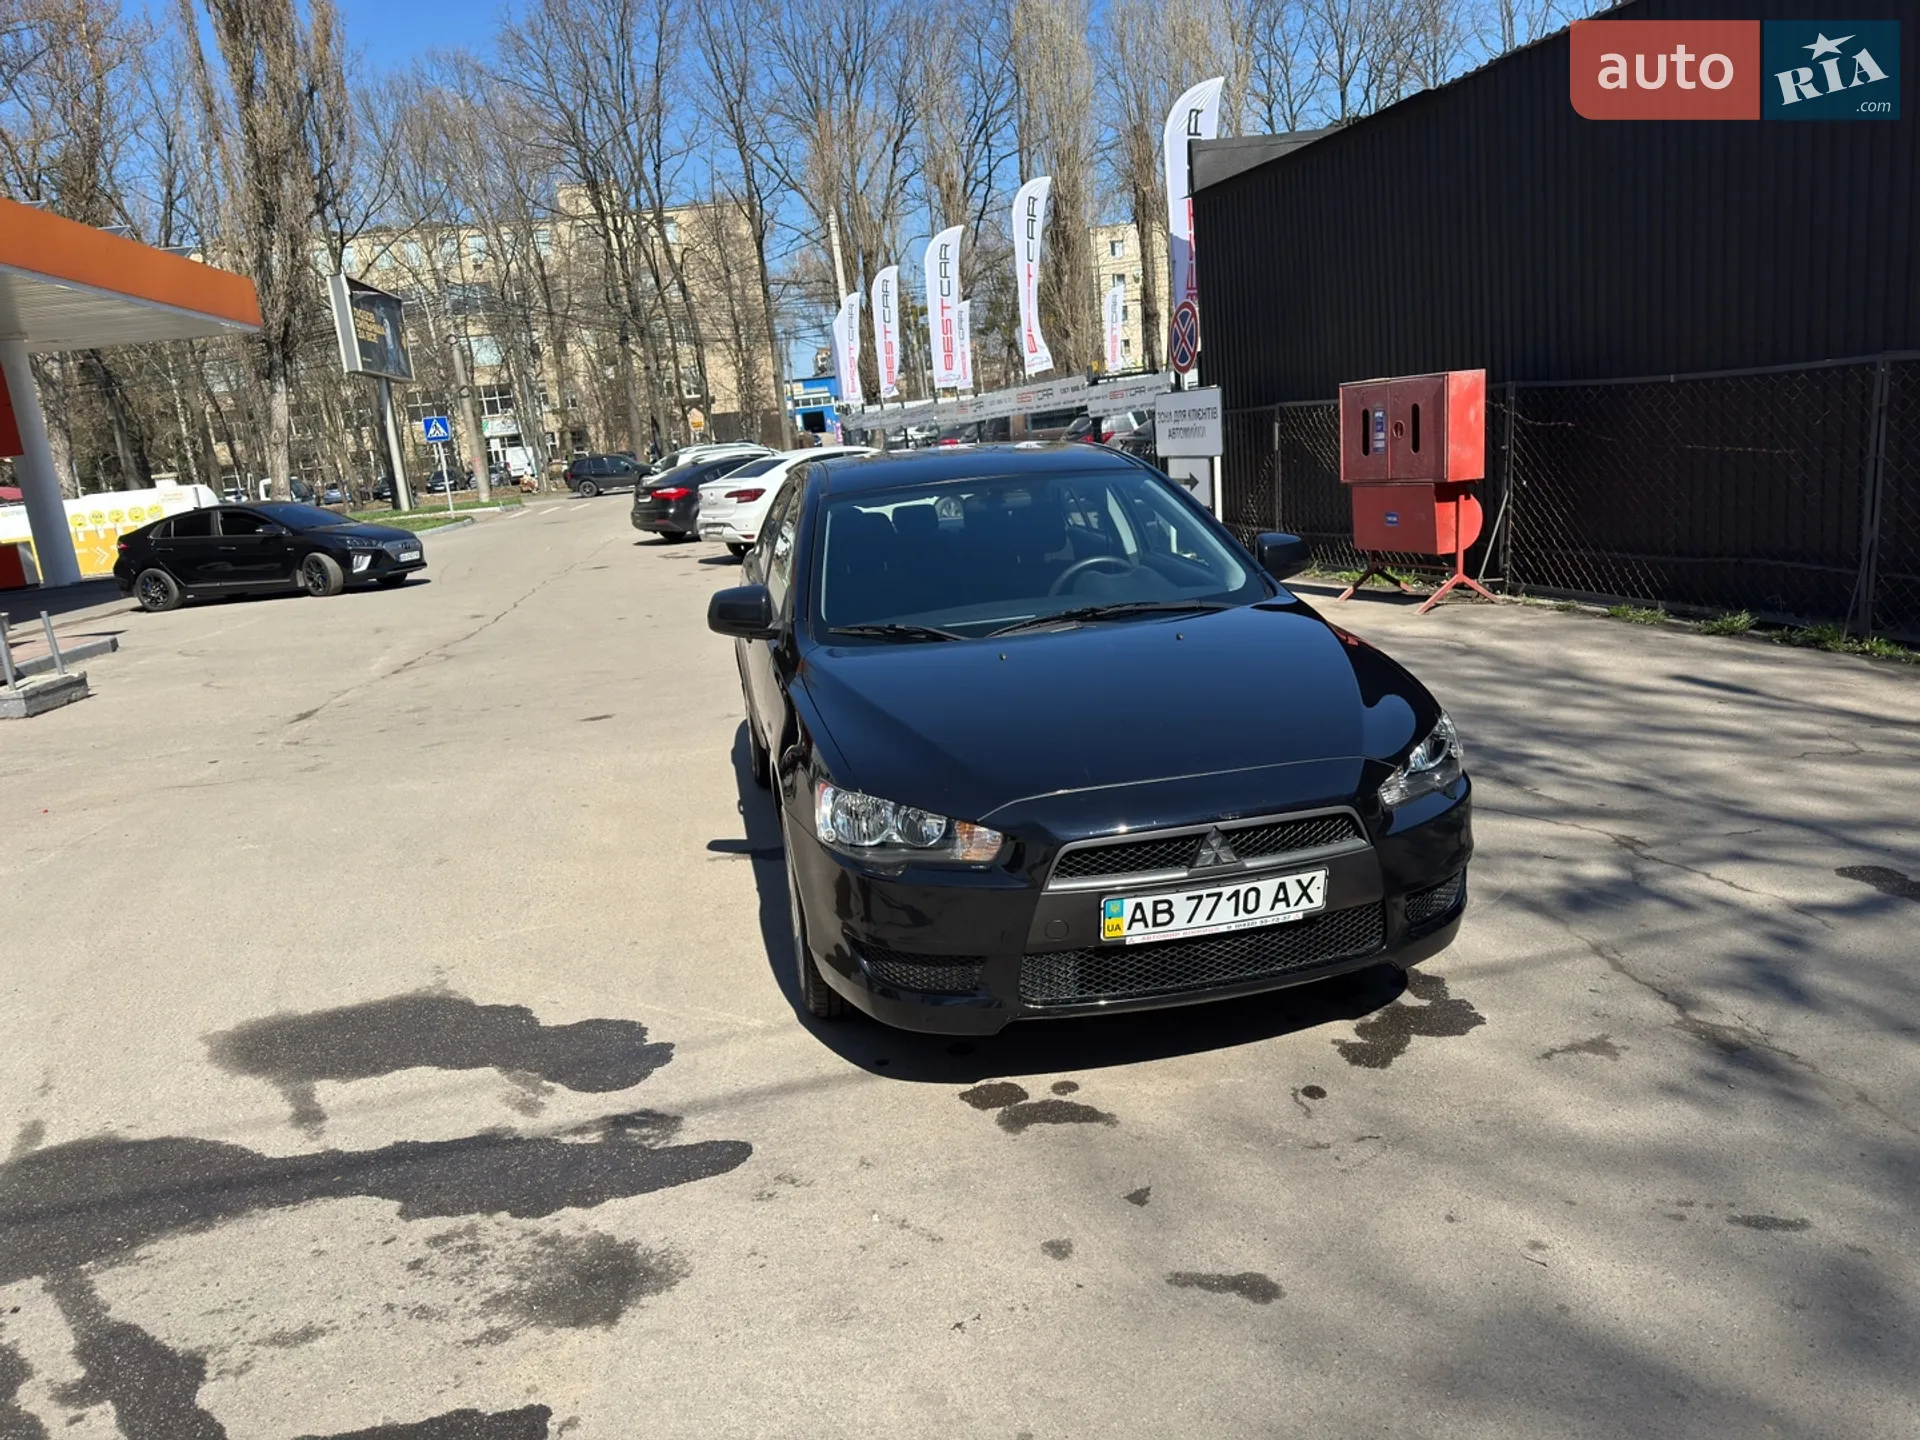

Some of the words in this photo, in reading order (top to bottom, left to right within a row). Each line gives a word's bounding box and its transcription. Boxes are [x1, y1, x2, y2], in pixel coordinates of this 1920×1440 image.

[939, 243, 953, 371] BESTCAR
[881, 279, 895, 385] BESTCAR
[1016, 388, 1054, 404] BESTCAR
[1109, 385, 1146, 400] BESTCAR
[1157, 411, 1172, 424] ЗОНА
[1173, 409, 1186, 424] ДЛЯ
[1188, 407, 1218, 421] КЛІЄНТІВ
[1168, 424, 1206, 439] АВТОМИЙКИ
[1127, 899, 1175, 931] AB
[1185, 887, 1261, 924] 7710
[1269, 876, 1317, 912] AX
[1106, 923, 1122, 933] UA
